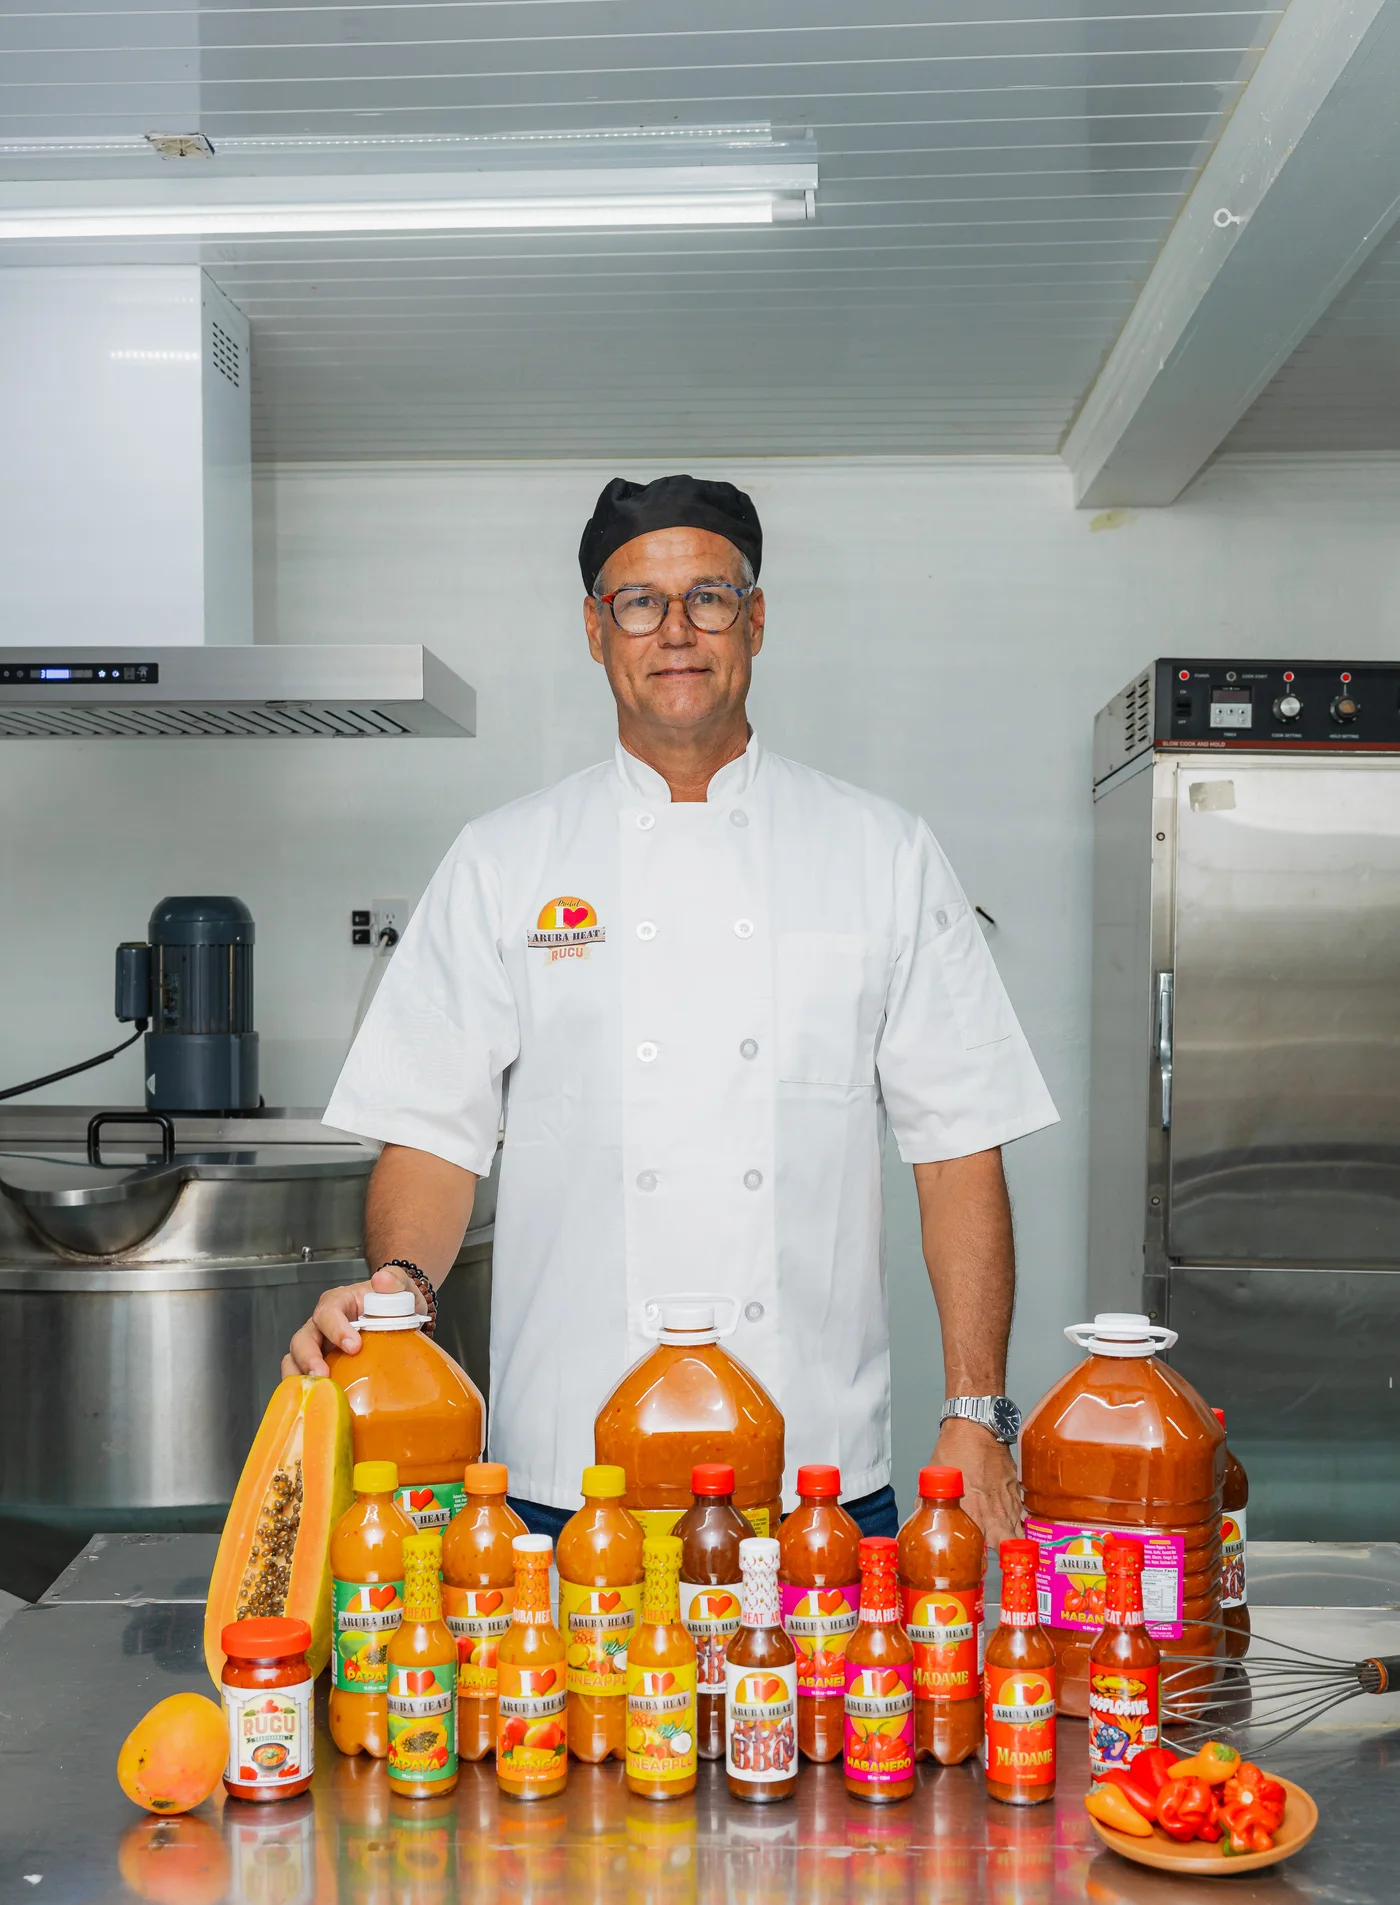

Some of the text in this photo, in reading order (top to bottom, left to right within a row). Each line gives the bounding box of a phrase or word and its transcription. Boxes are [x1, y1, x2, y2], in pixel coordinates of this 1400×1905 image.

[554, 906, 564, 928] I
[532, 929, 600, 942] ARUBA HEAT
[551, 947, 583, 961] RUCU
[401, 1490, 412, 1511] I
[420, 1513, 446, 1524] HEAT
[1081, 1531, 1093, 1554] I
[1225, 1543, 1243, 1554] HEAT
[1060, 1559, 1098, 1570] ARUBA
[359, 1587, 372, 1612] I
[466, 1591, 478, 1616] I
[590, 1592, 600, 1614] I
[699, 1595, 711, 1618] I
[808, 1590, 820, 1616] I
[341, 1612, 403, 1627] ARUBA HEA
[513, 1607, 533, 1624] UBA
[573, 1614, 632, 1628] ARUBA HEAT
[743, 1611, 764, 1625] HEAT
[861, 1607, 883, 1623] UBA
[926, 1604, 937, 1626] I
[1012, 1611, 1036, 1626] HEAT
[1061, 1611, 1105, 1625] HABAN
[1104, 1607, 1121, 1625] EAT
[1124, 1610, 1143, 1625] ARU
[449, 1617, 512, 1632] ARUBA HEA
[722, 1620, 741, 1631] HEA
[789, 1616, 856, 1632] ARUBA HEAT
[945, 1627, 970, 1638] HEAT
[397, 1669, 409, 1696] I
[458, 1677, 497, 1690] MANG
[520, 1671, 532, 1697] I
[566, 1671, 628, 1687] INEAPPL
[643, 1672, 654, 1695] I
[798, 1676, 845, 1688] ABANE
[861, 1669, 874, 1696] I
[914, 1668, 969, 1687] MADAME
[744, 1678, 755, 1702] I
[1013, 1683, 1025, 1706] I
[388, 1697, 414, 1713] RUBA
[501, 1694, 566, 1713] ARUBA HEAT
[630, 1695, 687, 1710] ARUBA HEAT
[732, 1703, 792, 1717] ARUBA HEAT
[846, 1696, 912, 1713] ARUBA HEAT
[1033, 1704, 1054, 1718] HEAT
[243, 1715, 295, 1737] RUCU
[731, 1732, 795, 1773] BBQ
[995, 1745, 1053, 1767] MADAME
[388, 1754, 440, 1772] PAPAYA
[506, 1755, 561, 1773] MANGO
[847, 1756, 912, 1773] HABANERO
